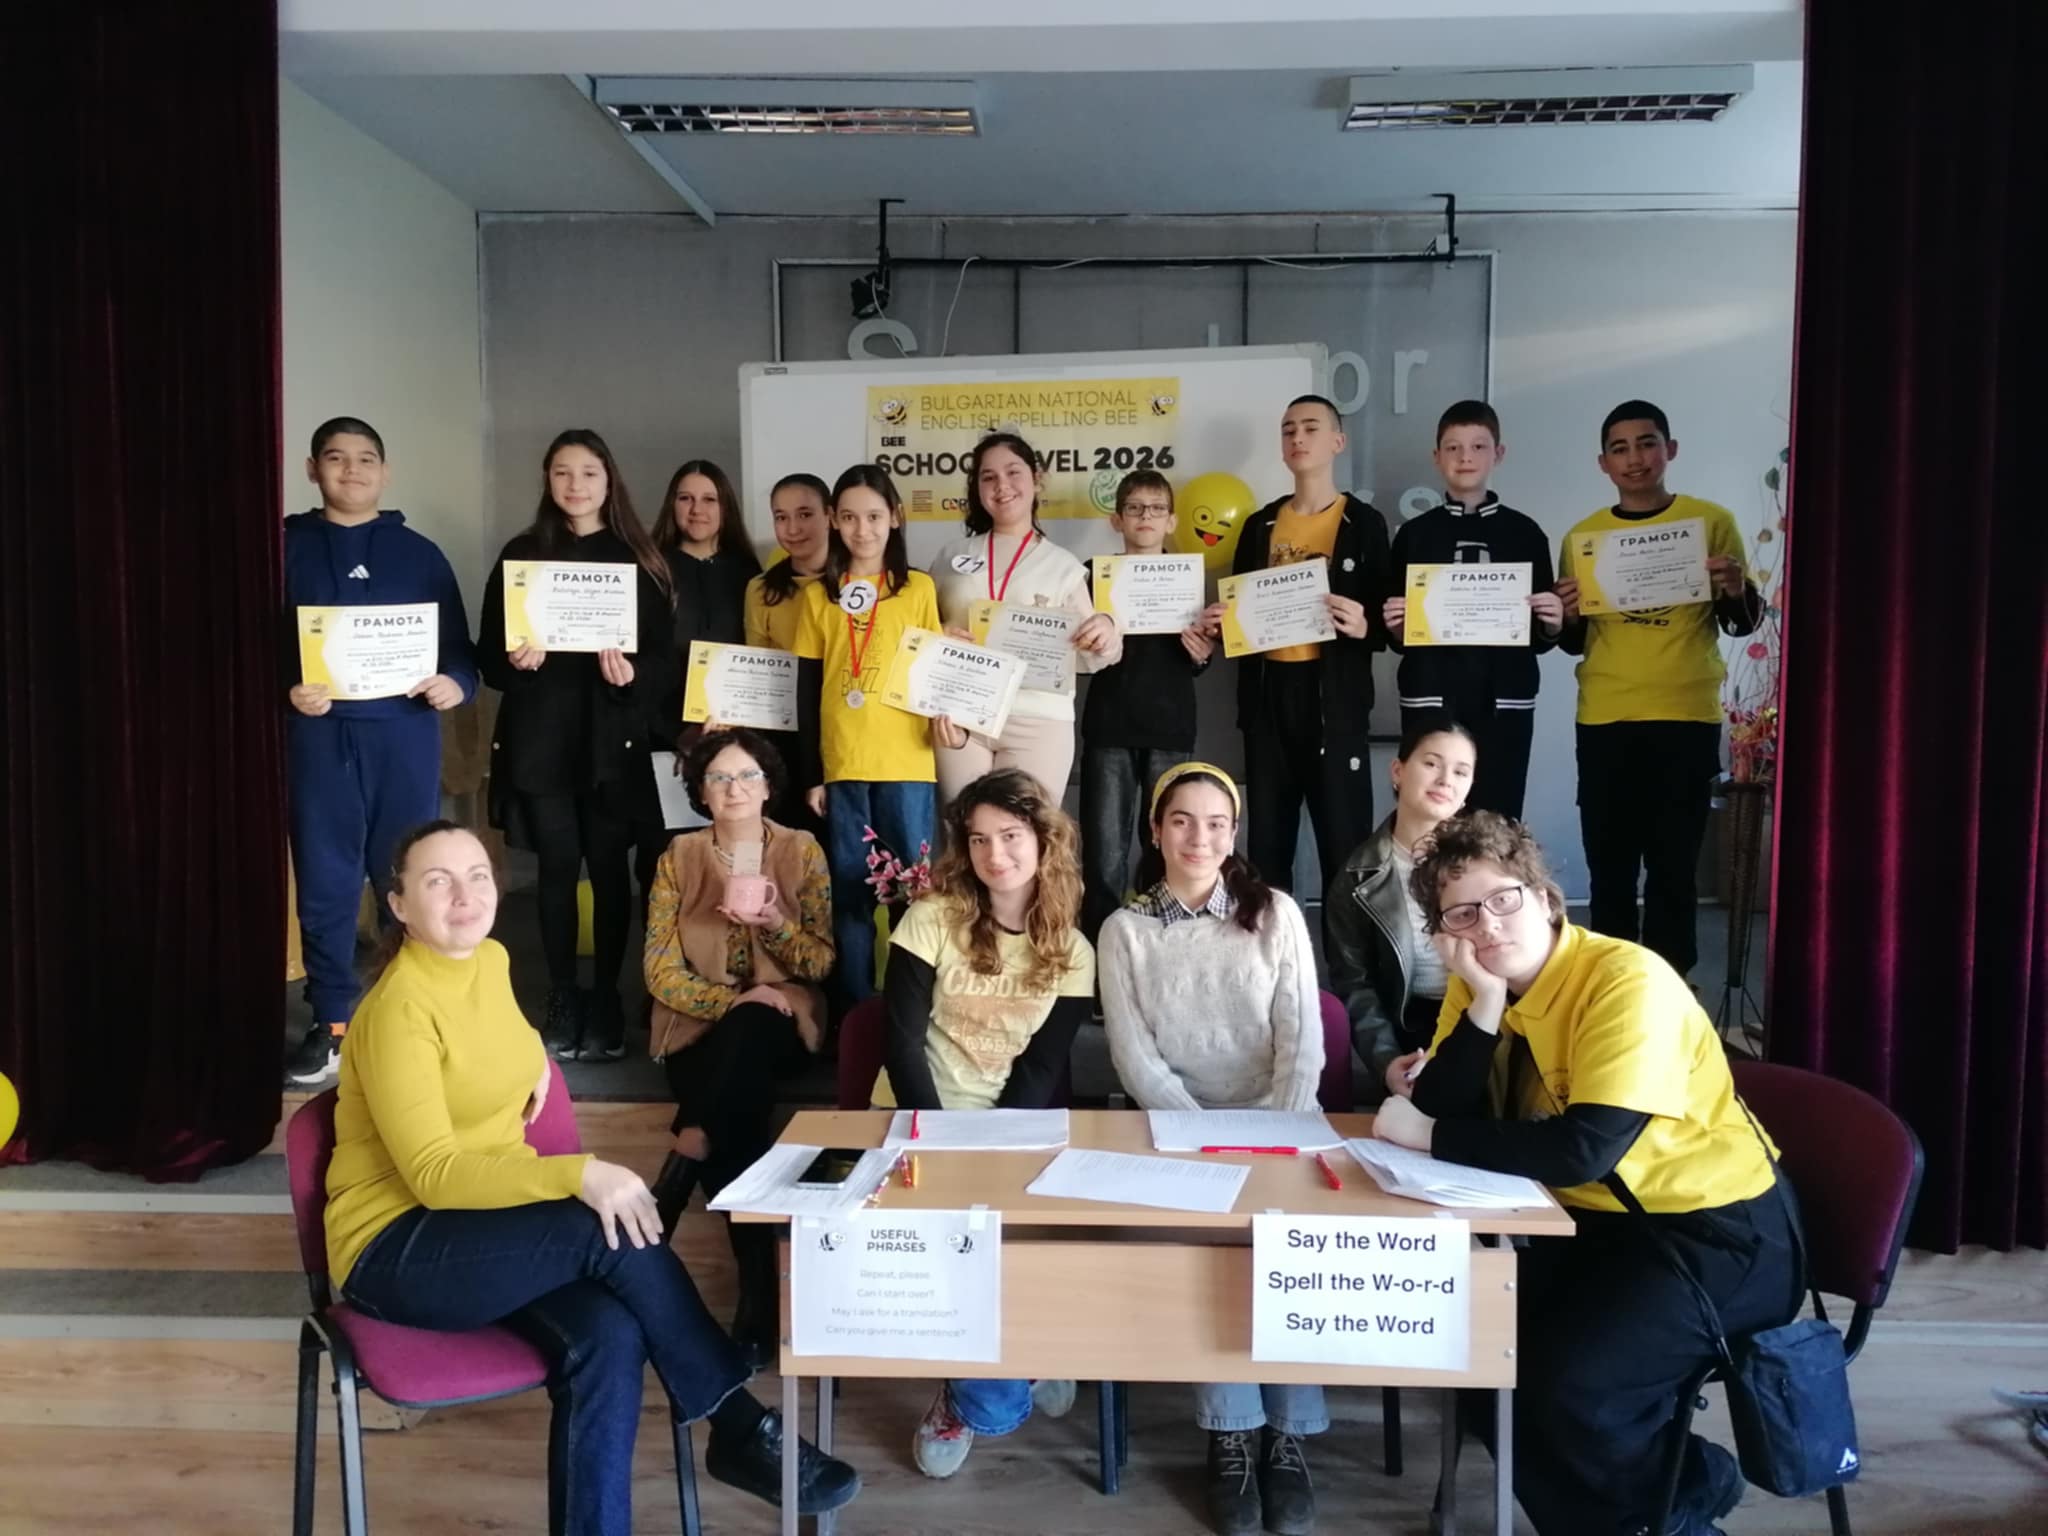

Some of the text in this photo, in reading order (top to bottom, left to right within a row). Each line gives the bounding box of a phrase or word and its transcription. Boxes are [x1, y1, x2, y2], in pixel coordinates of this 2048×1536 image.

[920, 389, 1137, 411] BULGARIAN NATIONAL
[921, 412, 1000, 430] ENGLISH
[1105, 409, 1138, 425] BEE
[881, 436, 906, 447] BEE
[875, 452, 974, 476] SCHOO
[1093, 446, 1175, 470] 2026
[1620, 530, 1690, 547] ГРАМОТА
[1134, 563, 1191, 573] ГРАМОТА
[553, 573, 622, 584] ГРАМОТА
[1256, 570, 1314, 589] ГРАМОТА
[1452, 573, 1516, 582] ГРАМОТА
[848, 586, 866, 610] 5
[353, 616, 424, 627] ГРАМОТА
[1012, 613, 1067, 630] ГРАМОТА
[732, 655, 792, 668] ГРАМОТА
[942, 647, 1001, 669] ГРАМОТА
[871, 1229, 920, 1240] USEFUL
[1287, 1229, 1436, 1253] Say the Word
[867, 1241, 927, 1253] PHRASES
[860, 1269, 896, 1280] Repeat,
[1268, 1271, 1455, 1294] Spell the W-o-r-d
[857, 1288, 876, 1298] Can
[884, 1289, 905, 1298] start
[908, 1289, 935, 1299] over?
[832, 1307, 852, 1318] May
[877, 1307, 890, 1316] for
[1286, 1312, 1434, 1335] Say the Word
[825, 1325, 845, 1334] Can
[846, 1326, 865, 1336] you
[866, 1327, 888, 1337] give
[916, 1327, 968, 1338] sentence?
